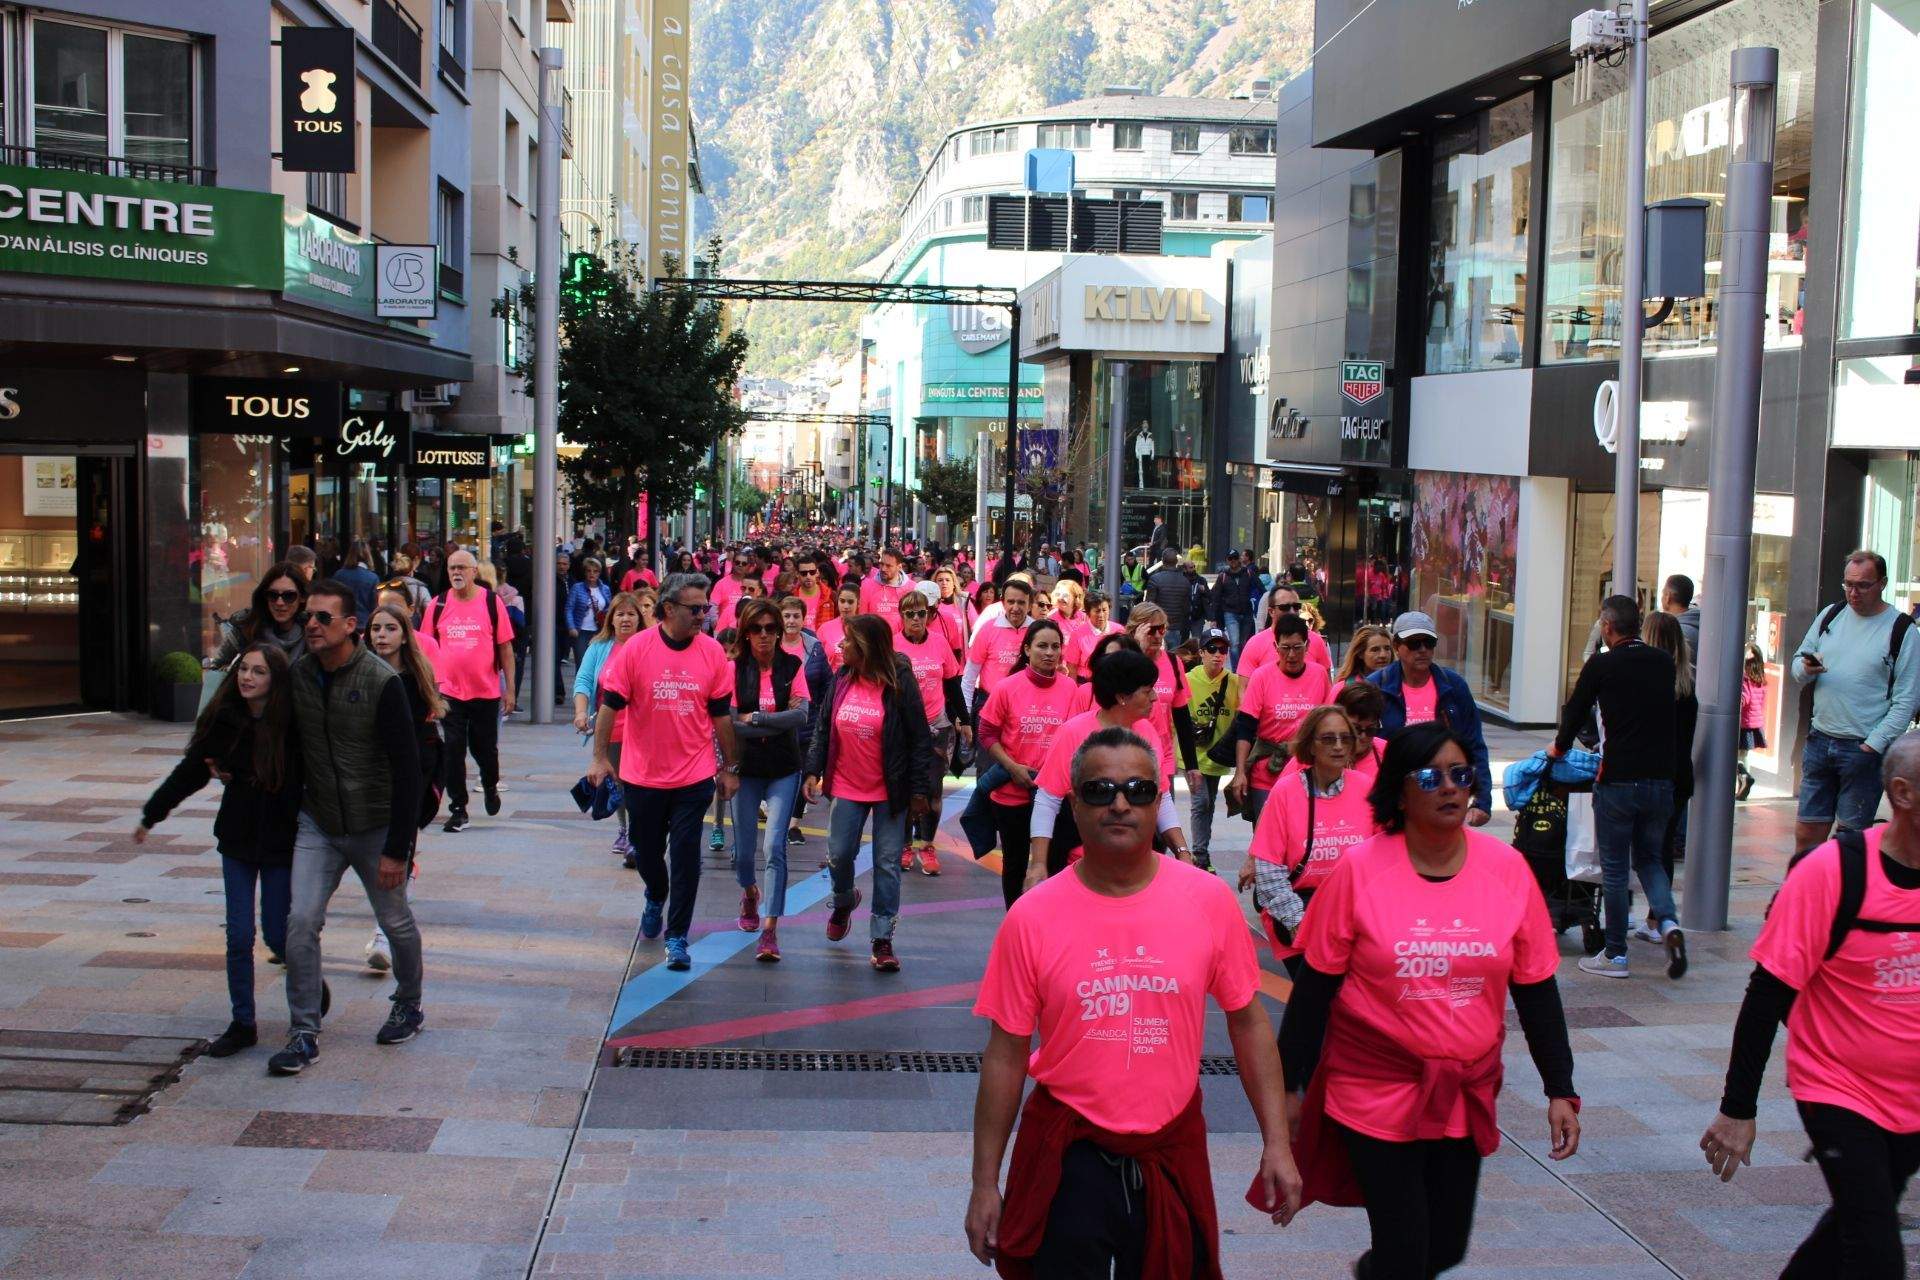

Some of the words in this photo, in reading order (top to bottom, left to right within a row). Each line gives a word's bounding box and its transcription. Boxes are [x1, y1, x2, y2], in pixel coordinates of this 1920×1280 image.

[661, 54, 681, 133] casa
[294, 120, 343, 133] TOUS
[0, 183, 215, 236] CENTRE
[659, 155, 680, 259] canut
[109, 243, 208, 266] CLÍNIQUES
[298, 227, 361, 276] LABORATORI
[1346, 365, 1379, 380] TAG
[968, 387, 1005, 398] CENTRE
[1346, 383, 1378, 400] HEUER
[225, 395, 310, 419] TOUS
[988, 422, 1031, 433] GUSS
[336, 416, 396, 458] Galy
[416, 450, 486, 466] LOTTUSSE
[653, 681, 700, 692] CAMINADA
[653, 689, 678, 700] 2019
[1020, 716, 1063, 725] CAMINADA
[1275, 711, 1297, 720] 2019
[1020, 723, 1043, 734] 2019
[1393, 941, 1498, 957] CAMINADA
[1395, 957, 1449, 978] 2019
[1080, 992, 1130, 1020] 2019
[1133, 1017, 1169, 1027] SUMEM
[1132, 1036, 1168, 1045] SUMEM
[1132, 1046, 1155, 1055] VIDA
